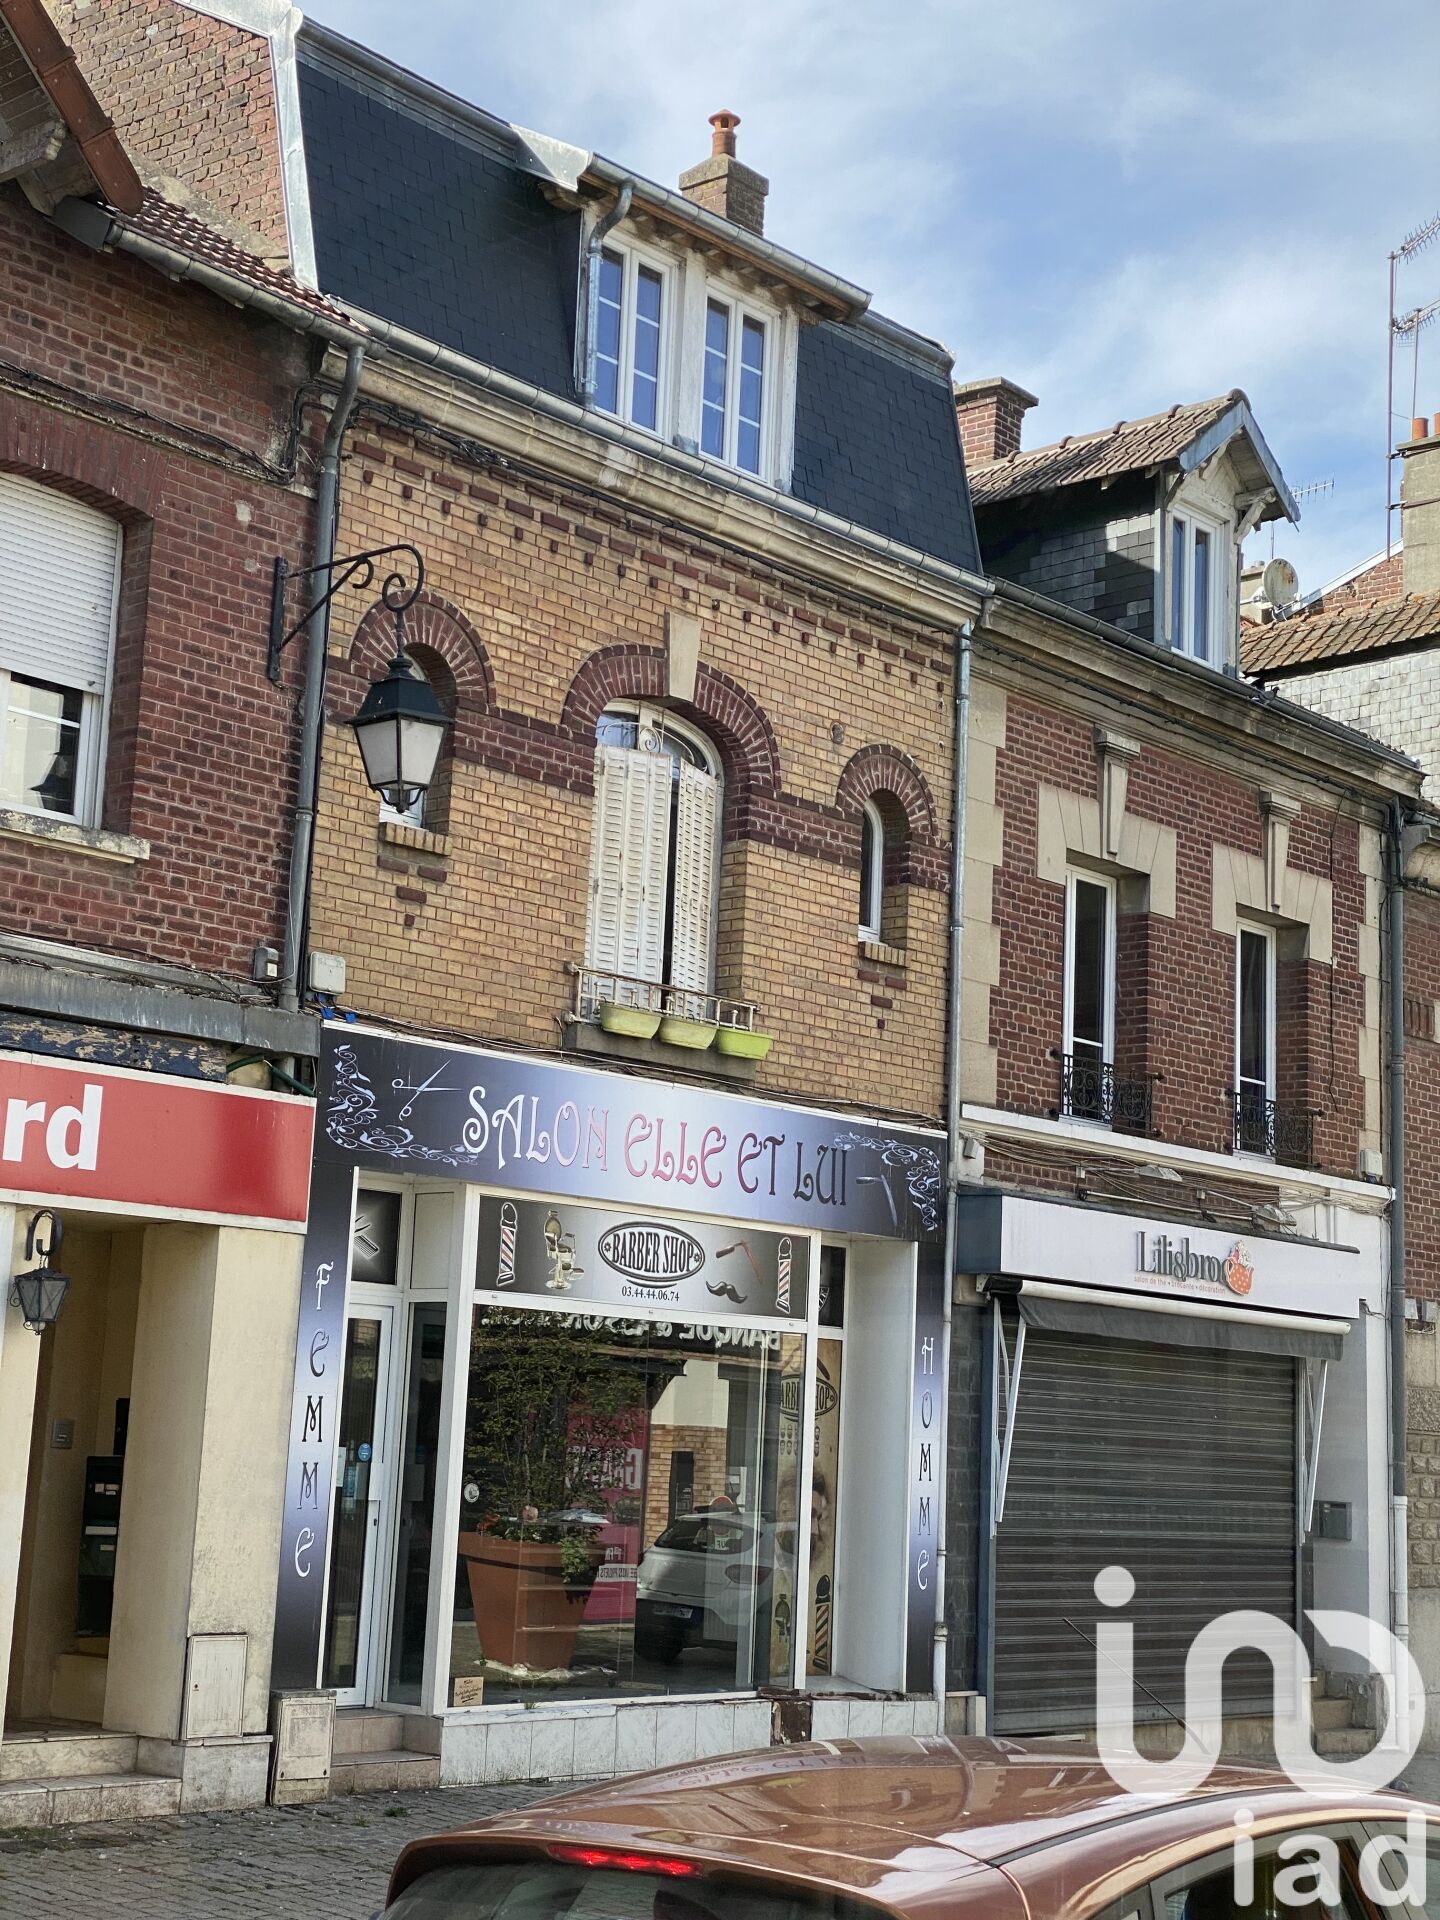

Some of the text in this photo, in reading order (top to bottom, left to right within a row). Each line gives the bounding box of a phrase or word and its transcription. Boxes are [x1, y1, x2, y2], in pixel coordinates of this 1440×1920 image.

[3, 1084, 104, 1171] rd
[462, 1085, 849, 1206] SALON ELLE ET LUI
[612, 1231, 695, 1274] BARBER SHOP
[621, 1285, 680, 1302] 03.44.44.06.74
